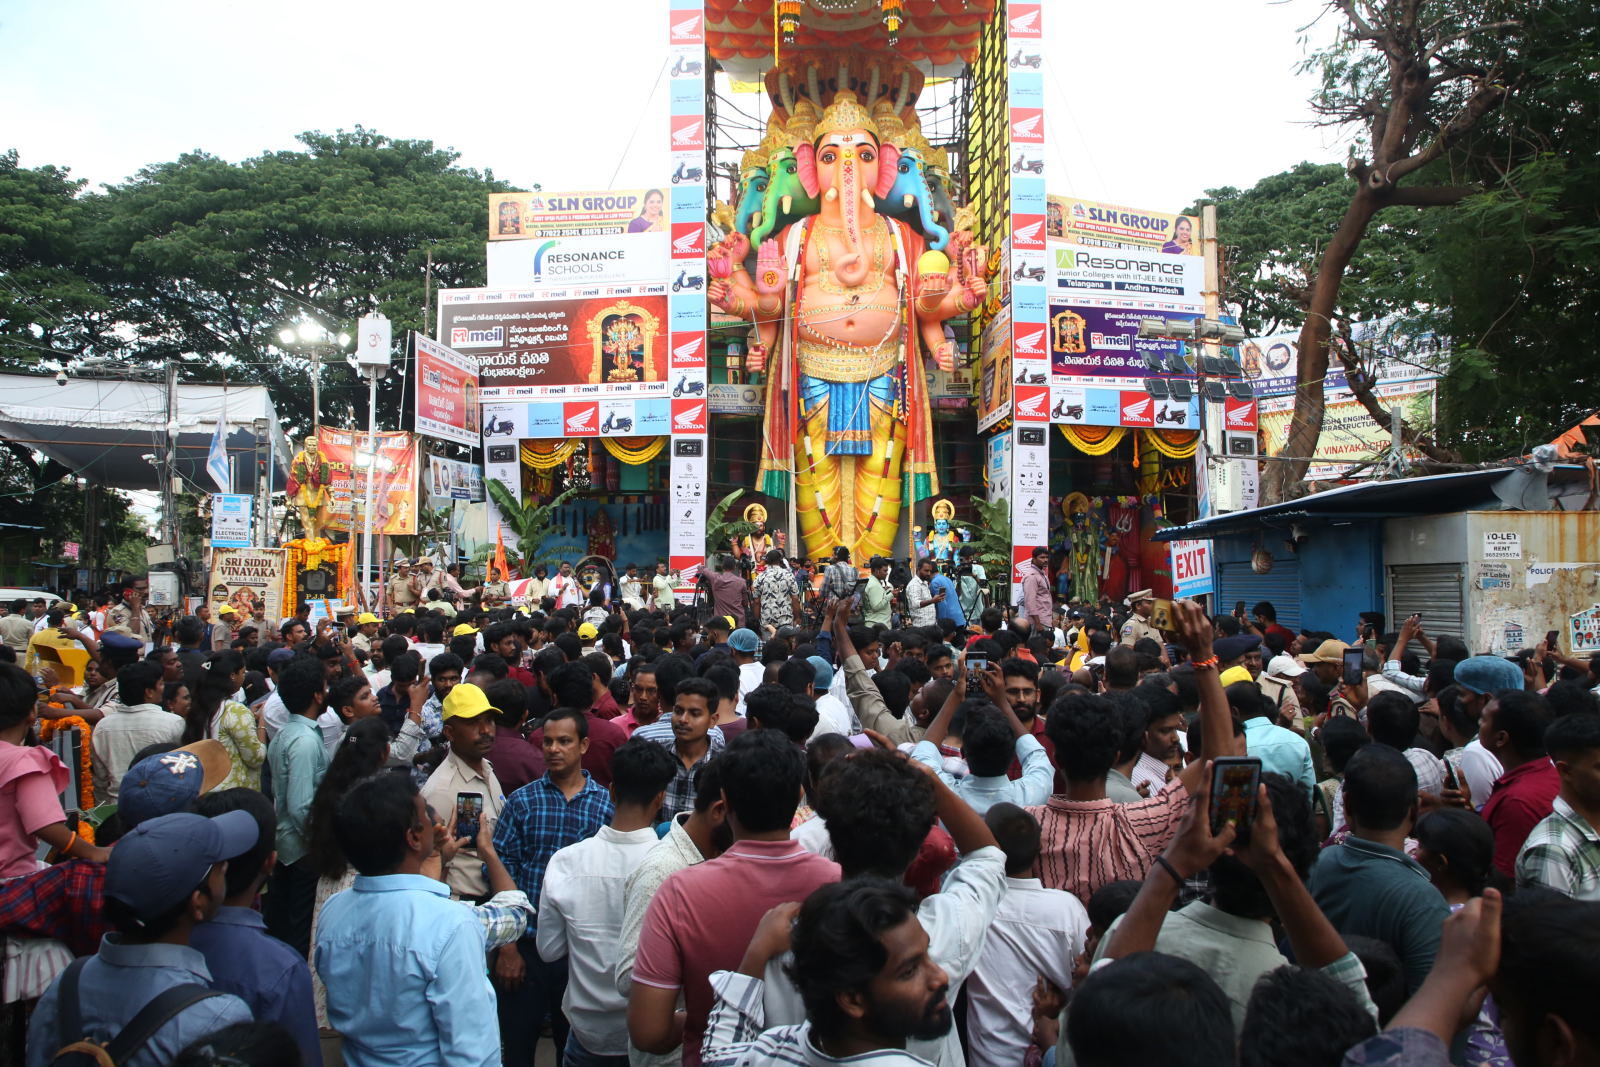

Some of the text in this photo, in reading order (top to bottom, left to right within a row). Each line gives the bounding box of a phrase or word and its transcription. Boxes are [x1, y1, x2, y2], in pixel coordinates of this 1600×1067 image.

[548, 196, 637, 212] SLN GROUP
[1089, 208, 1117, 224] SLN
[1120, 214, 1169, 231] GROUP
[548, 250, 624, 263] RESONANCE
[548, 263, 603, 275] SCHOOLS
[1076, 252, 1184, 275] Resonance
[1082, 271, 1114, 280] Colleges
[1133, 274, 1157, 282] IIT-JEE
[1066, 280, 1104, 289] Telangana
[1124, 283, 1178, 294] Andhra Pradesh
[470, 327, 502, 341] meil
[1106, 333, 1130, 346] meil
[520, 352, 549, 364] చవితి
[1065, 356, 1101, 365] వినాయక
[1103, 357, 1124, 366] చవితి
[1324, 443, 1367, 454] VINAYAKA
[225, 558, 272, 567] SRI SIDDI
[1176, 548, 1205, 579] EXIT
[220, 567, 276, 577] VINAYAKA
